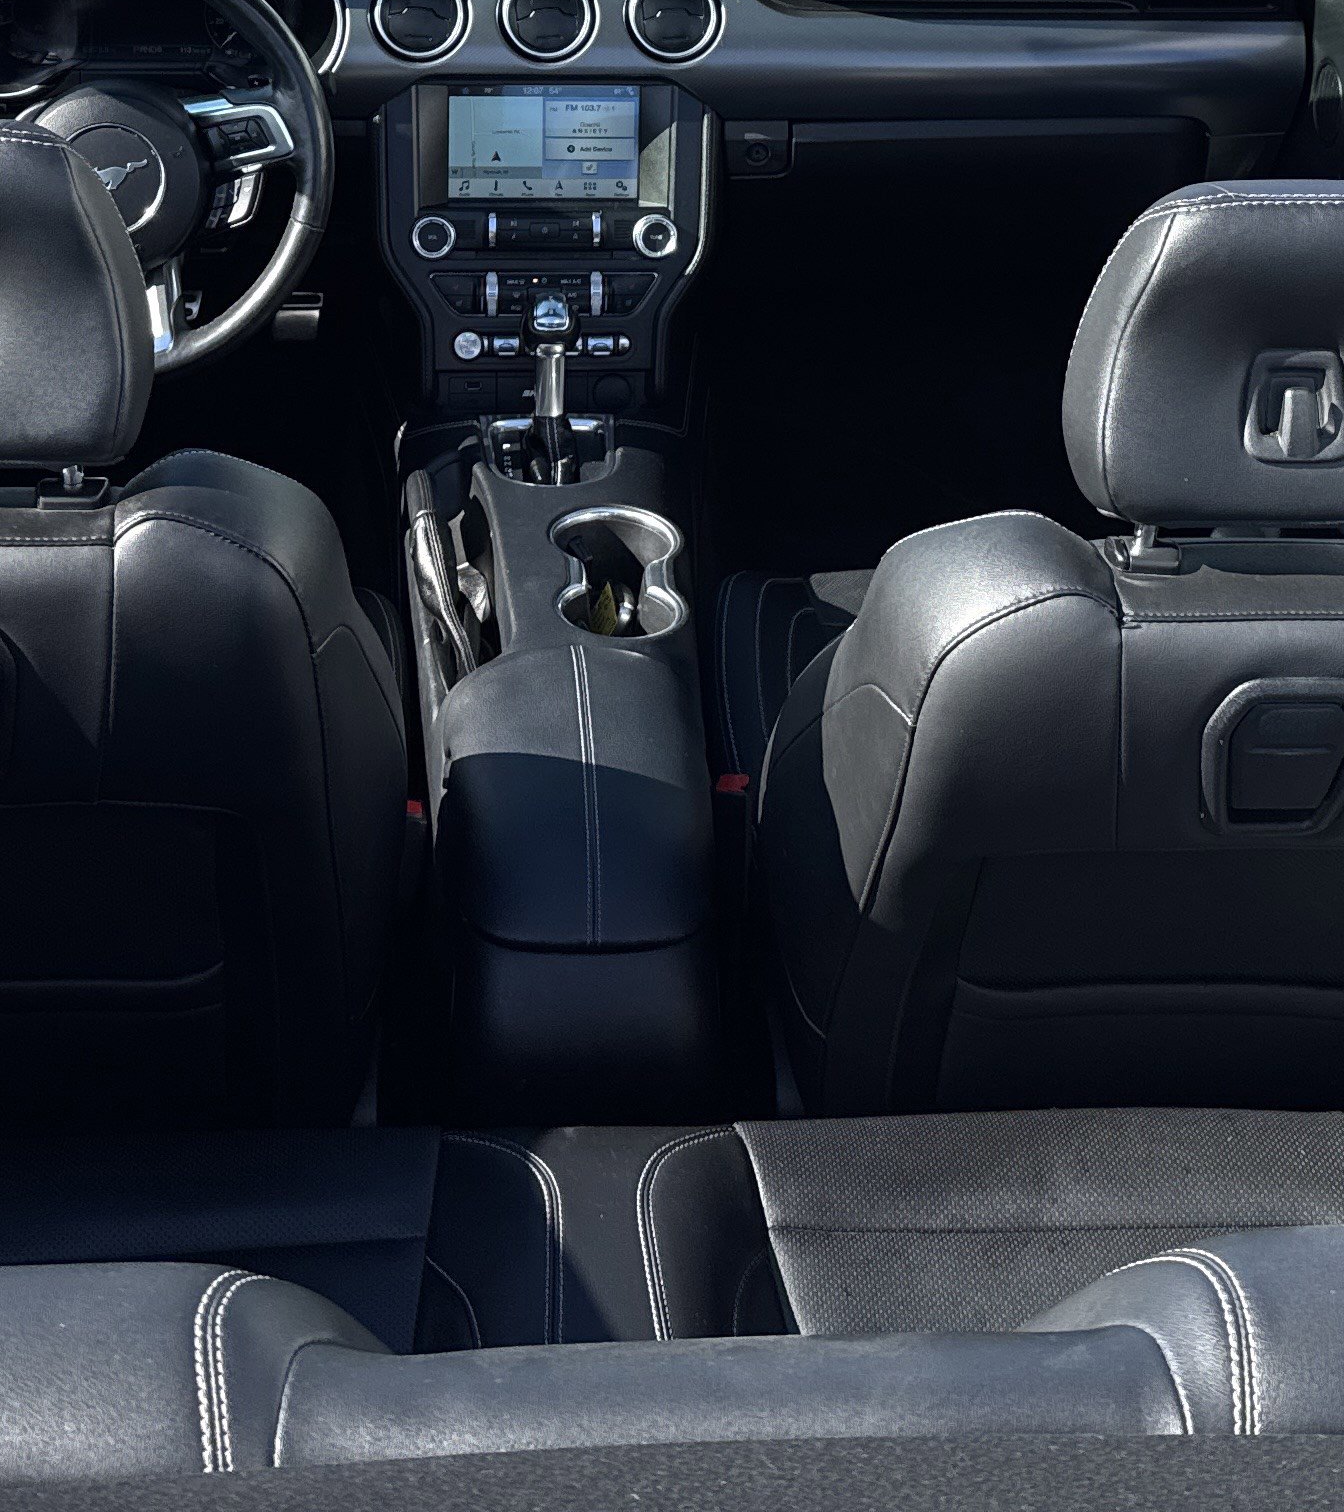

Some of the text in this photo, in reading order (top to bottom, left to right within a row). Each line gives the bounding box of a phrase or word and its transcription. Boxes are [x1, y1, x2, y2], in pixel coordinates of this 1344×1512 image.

[522, 87, 544, 95] 12:07
[565, 104, 578, 112] FM
[580, 104, 601, 112] 103.7
